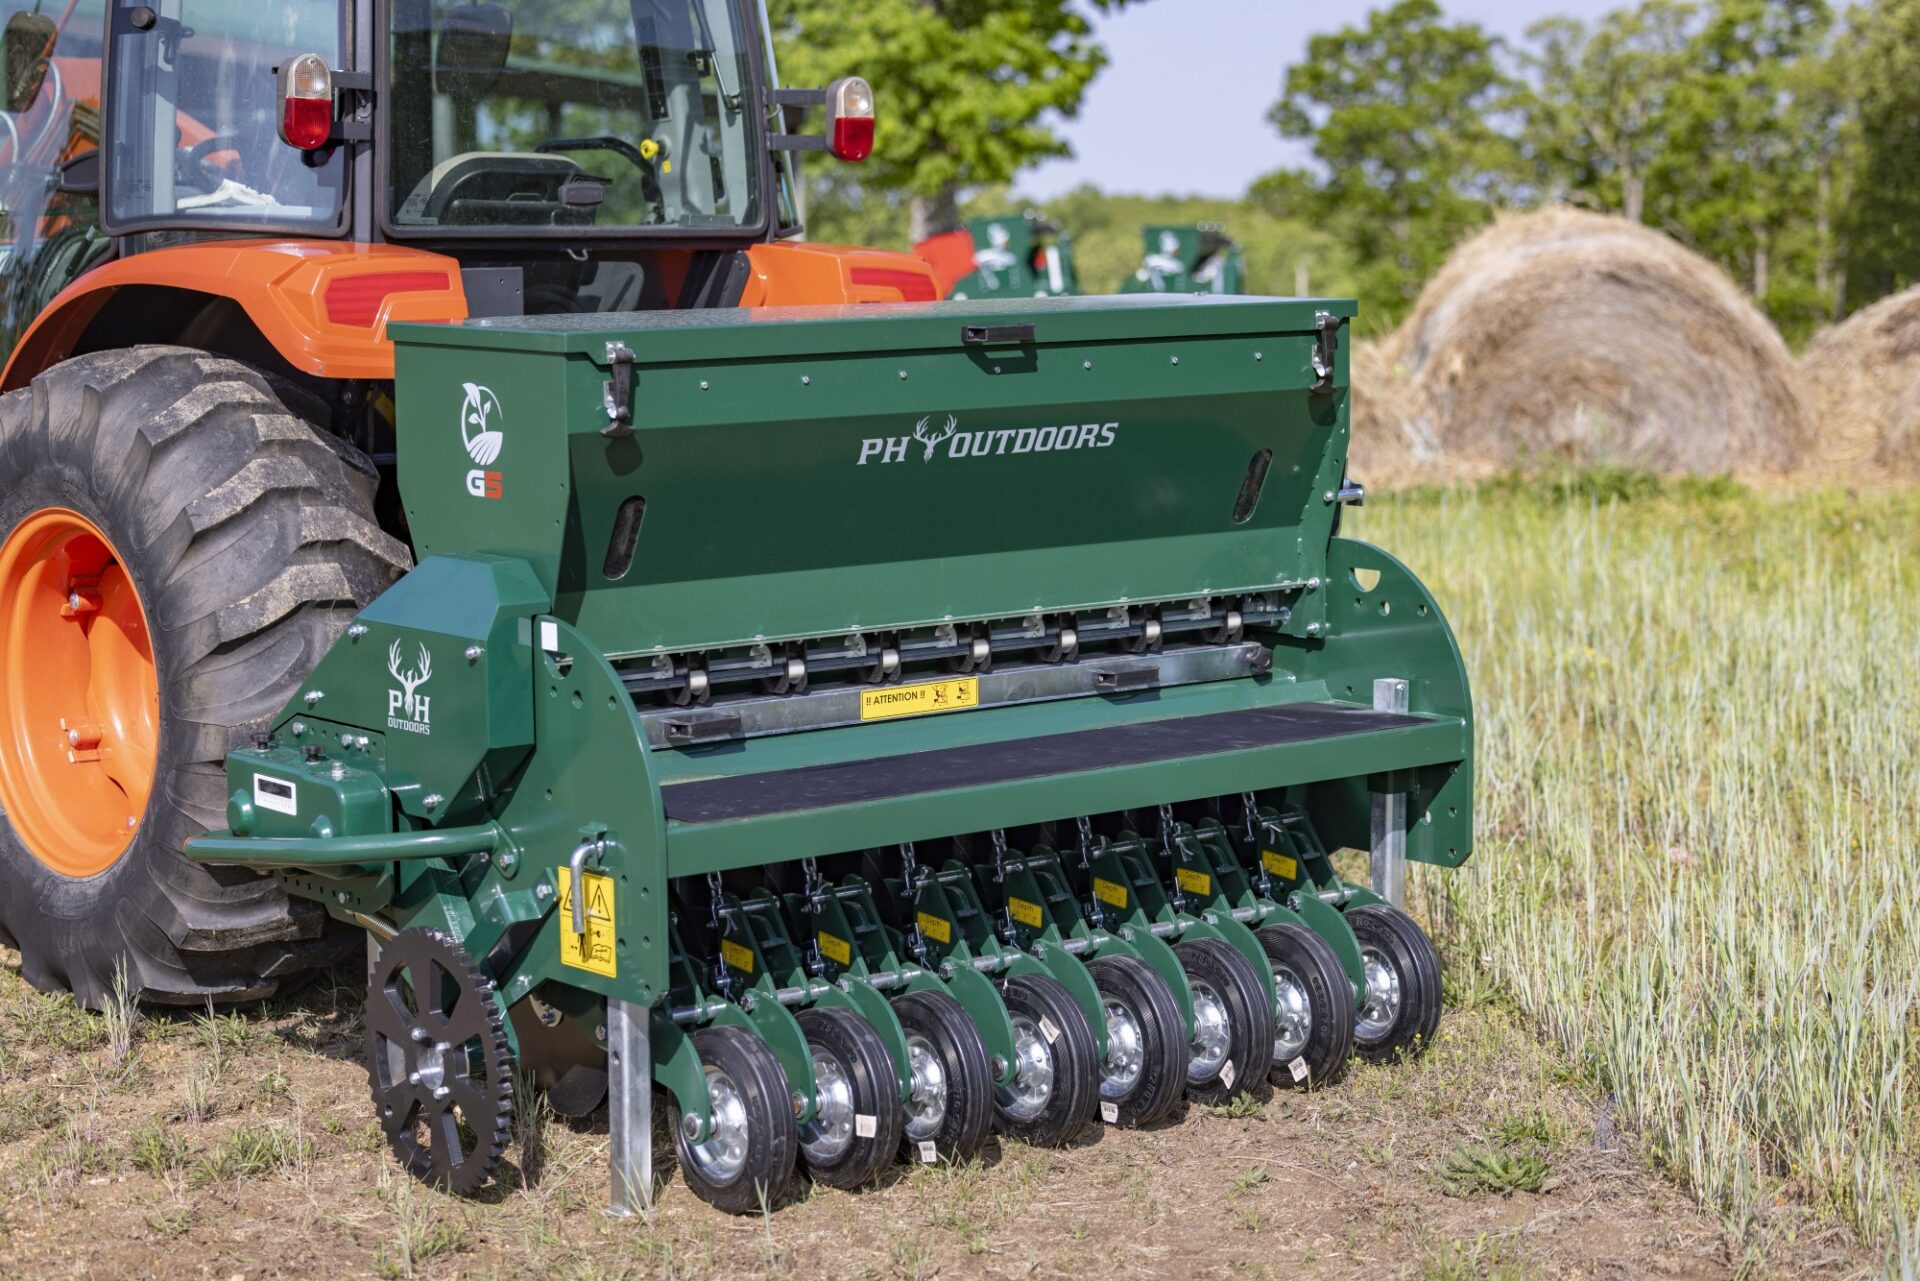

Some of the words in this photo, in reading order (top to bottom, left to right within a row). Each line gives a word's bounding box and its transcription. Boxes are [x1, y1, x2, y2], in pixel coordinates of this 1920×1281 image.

[856, 436, 911, 465] PH
[948, 422, 1119, 458] OUTDOORS
[873, 691, 918, 705] ATTENTION
[388, 717, 431, 735] OUTDOORS
